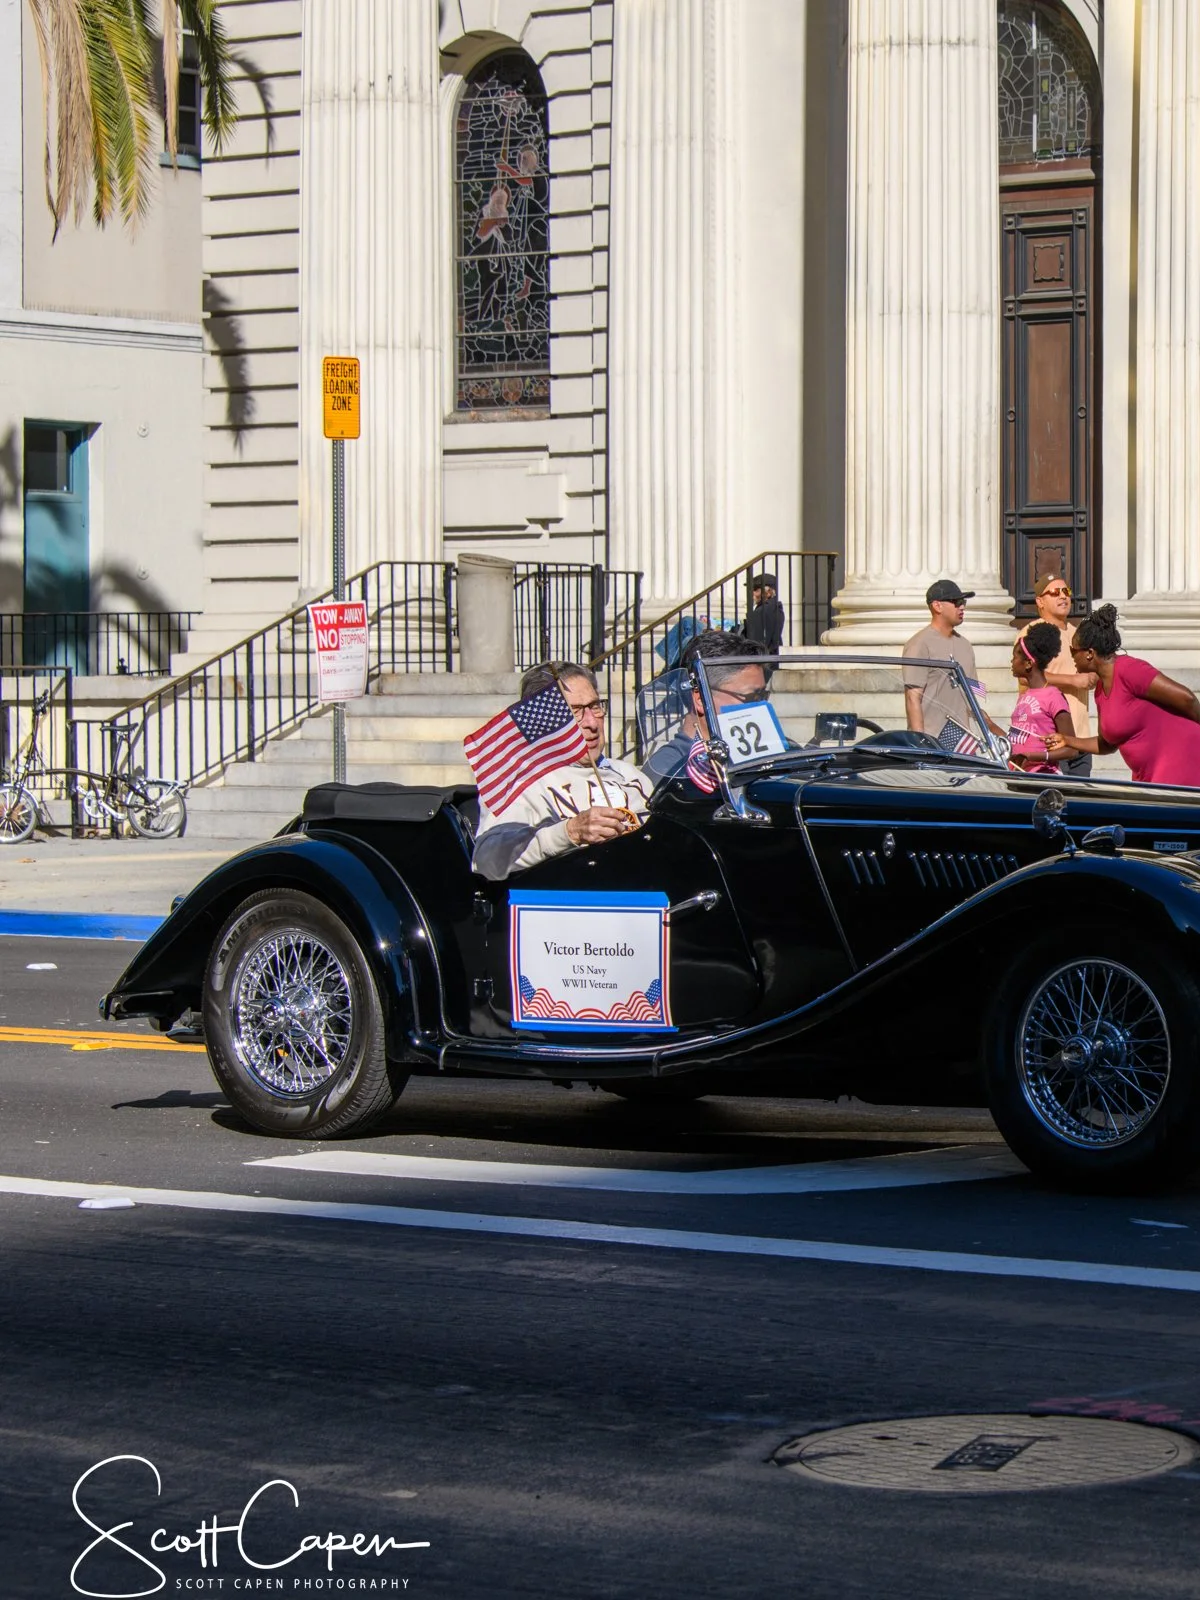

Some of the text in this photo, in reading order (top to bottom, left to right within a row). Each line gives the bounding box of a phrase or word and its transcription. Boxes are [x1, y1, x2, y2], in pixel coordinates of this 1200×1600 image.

[326, 363, 358, 378] FREIGHT
[325, 379, 359, 395] LOADING
[332, 396, 352, 411] ZONE
[314, 608, 338, 625] TOW
[343, 607, 363, 624] AWAY
[317, 628, 338, 649] NO
[340, 633, 366, 646] STOPPING
[730, 721, 769, 756] 32
[543, 941, 635, 957] Victor Bertoldo
[572, 965, 607, 977] US Navy
[562, 978, 618, 989] WWII Veteran
